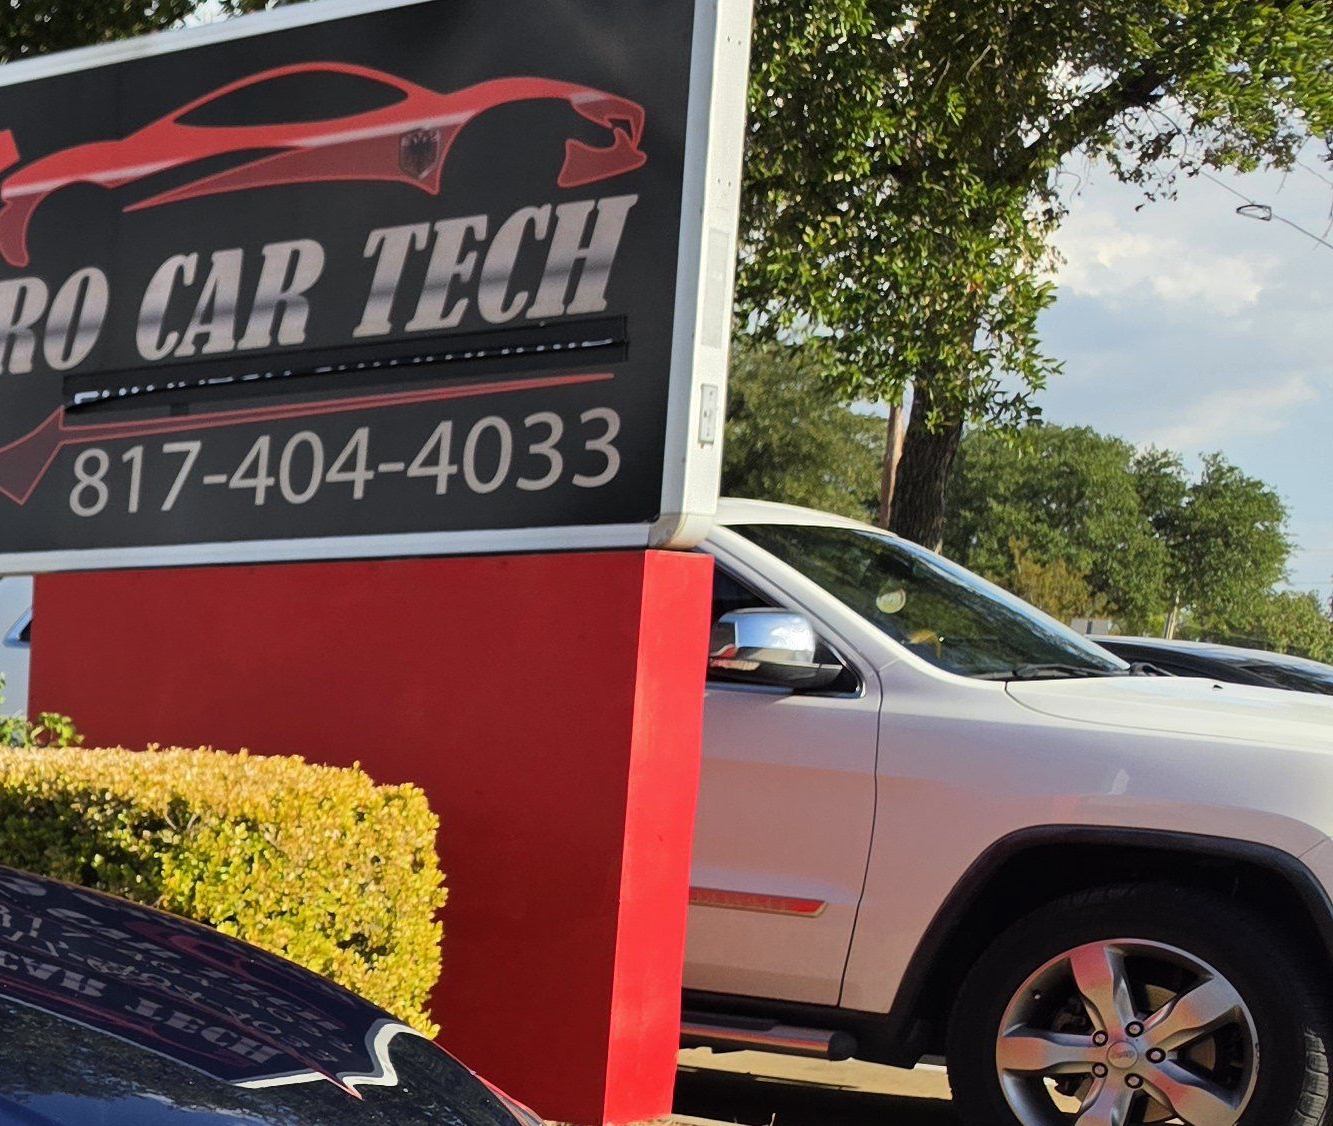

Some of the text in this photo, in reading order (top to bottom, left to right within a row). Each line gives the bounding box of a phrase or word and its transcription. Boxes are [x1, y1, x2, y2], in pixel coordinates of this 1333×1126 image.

[136, 238, 325, 361] CAR
[352, 193, 639, 338] TECH
[68, 406, 622, 518] 817-404-4033
